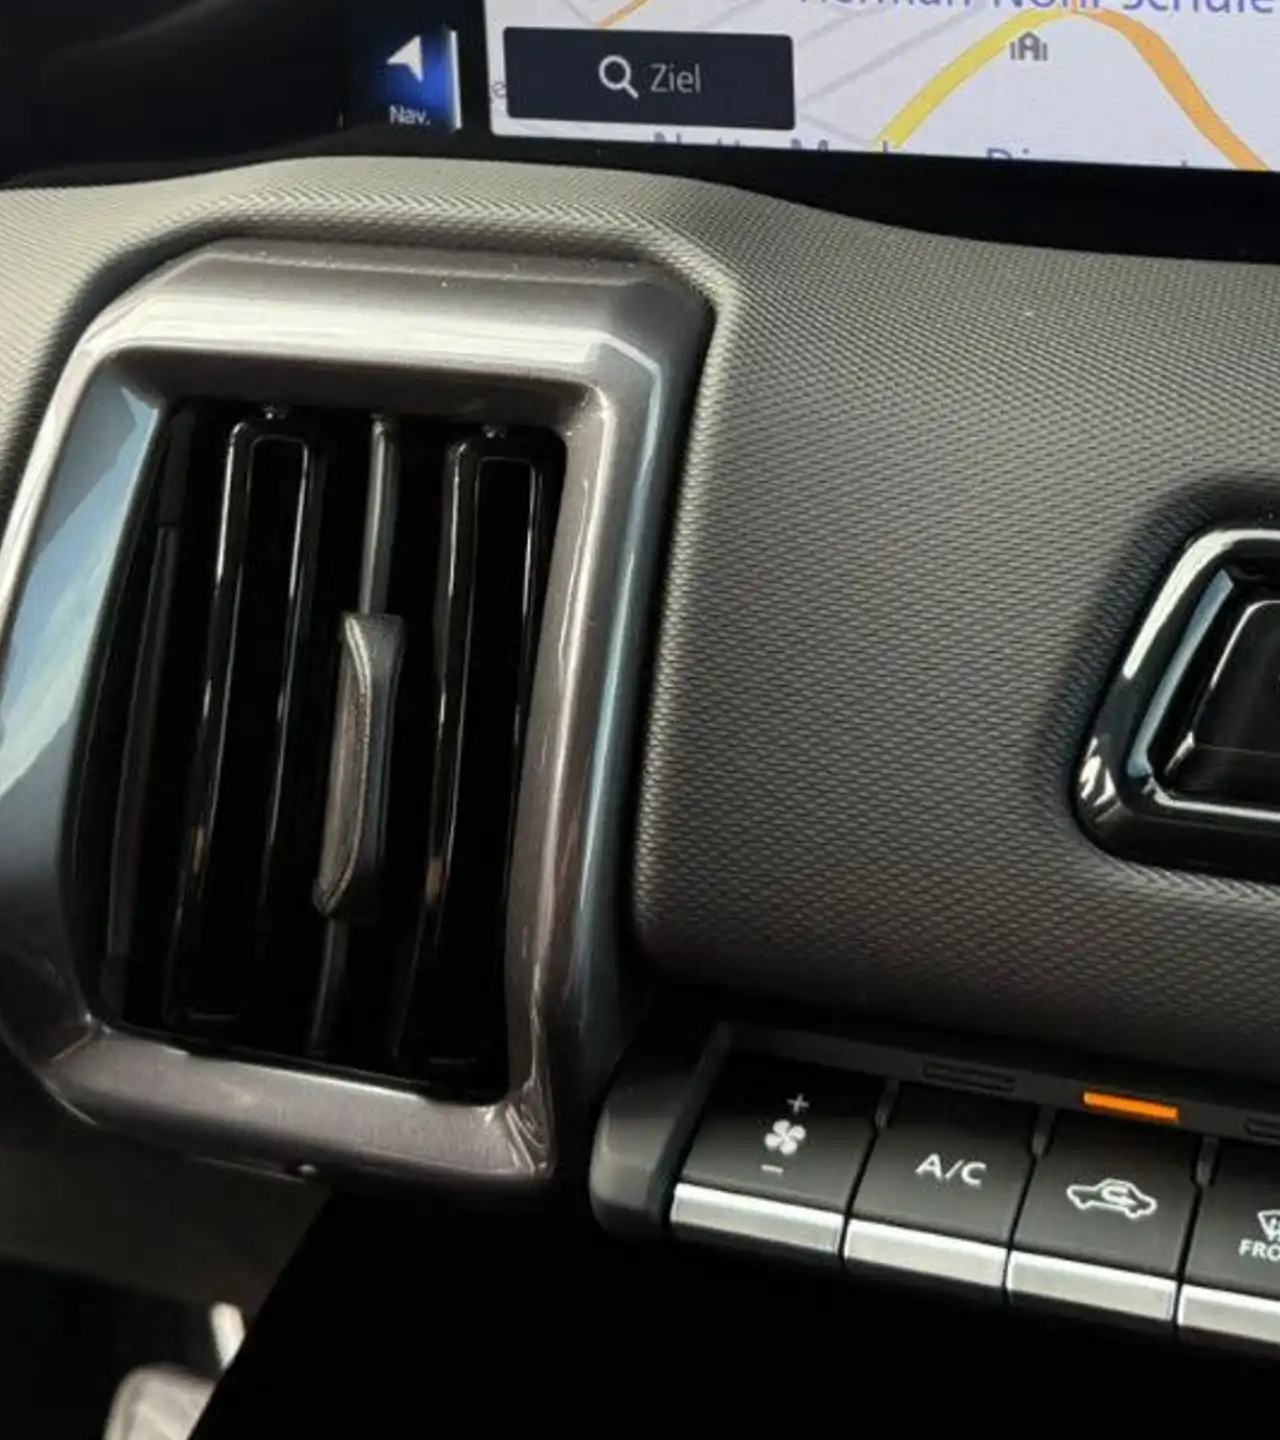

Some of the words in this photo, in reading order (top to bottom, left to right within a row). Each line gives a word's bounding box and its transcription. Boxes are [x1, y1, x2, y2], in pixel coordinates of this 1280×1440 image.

[649, 62, 703, 95] Ziel
[388, 103, 432, 126] Nav.
[915, 1152, 986, 1187] A/C
